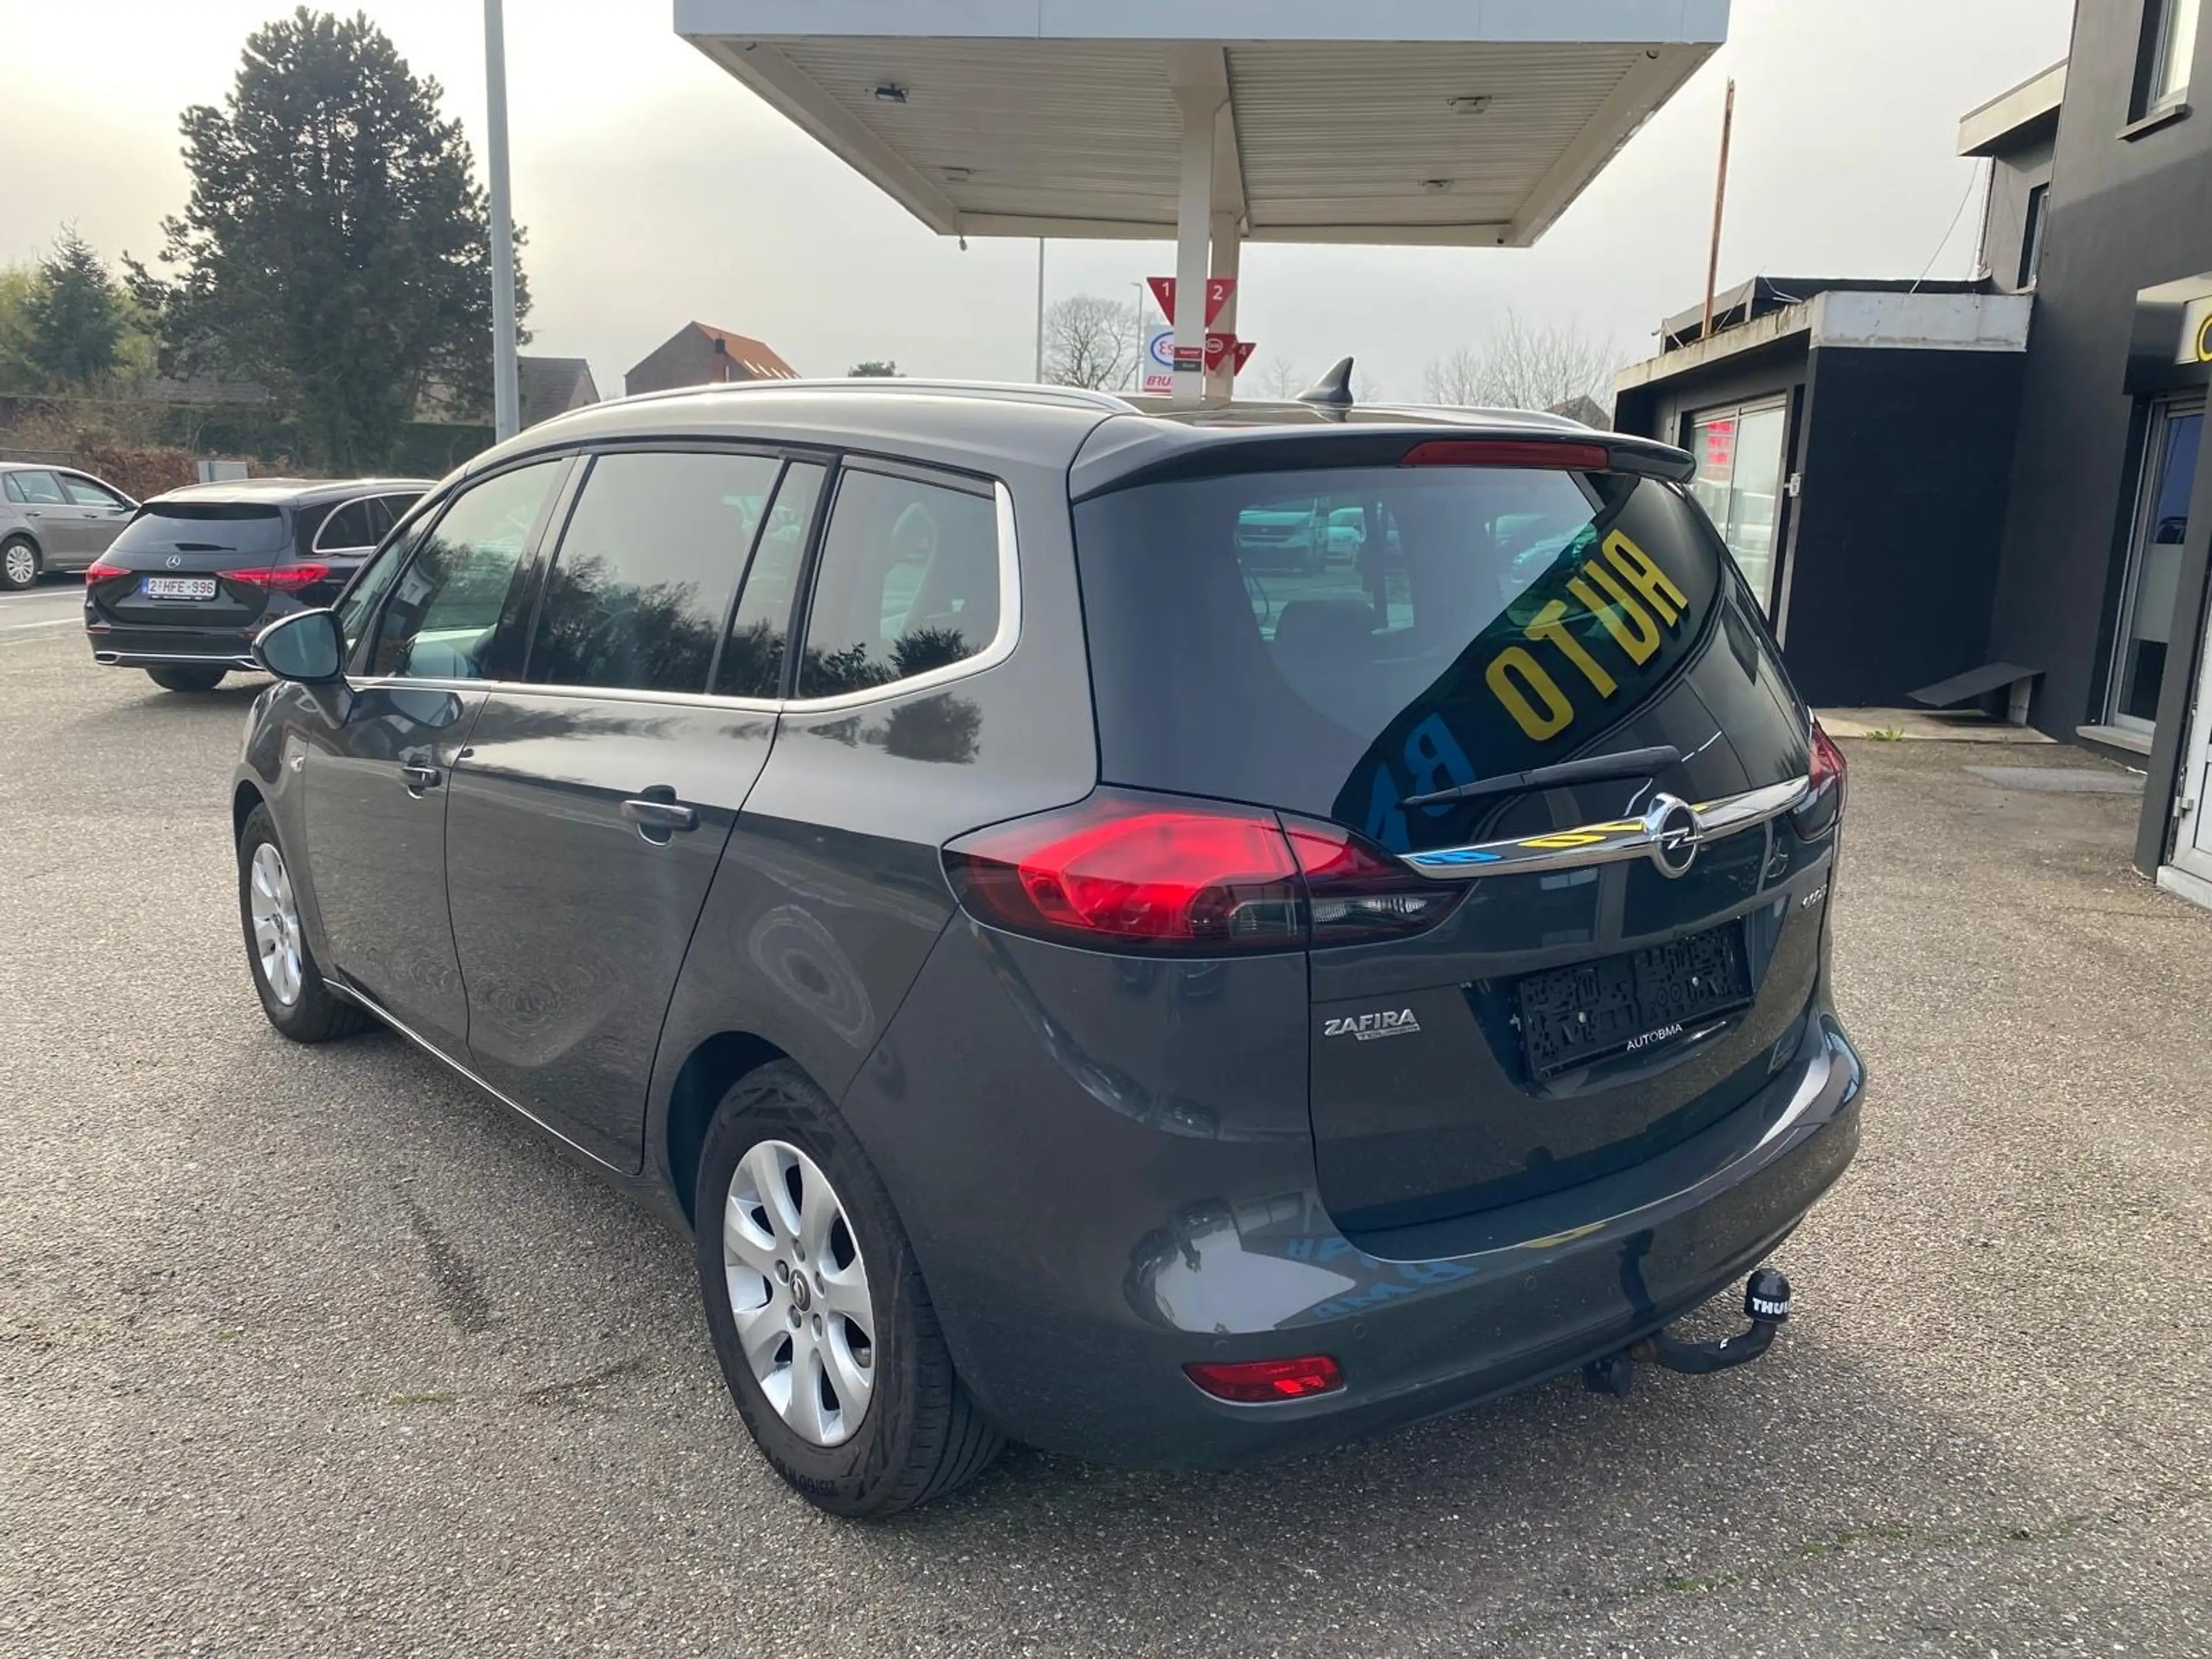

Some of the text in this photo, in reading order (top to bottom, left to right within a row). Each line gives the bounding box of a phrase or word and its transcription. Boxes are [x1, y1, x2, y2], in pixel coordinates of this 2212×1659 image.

[1162, 282, 1169, 297] 1
[1212, 285, 1224, 300] 2
[1158, 341, 1173, 355] Es
[1324, 1009, 1418, 1036] ZAFIRA
[1626, 1024, 1683, 1051] AUTOBMA
